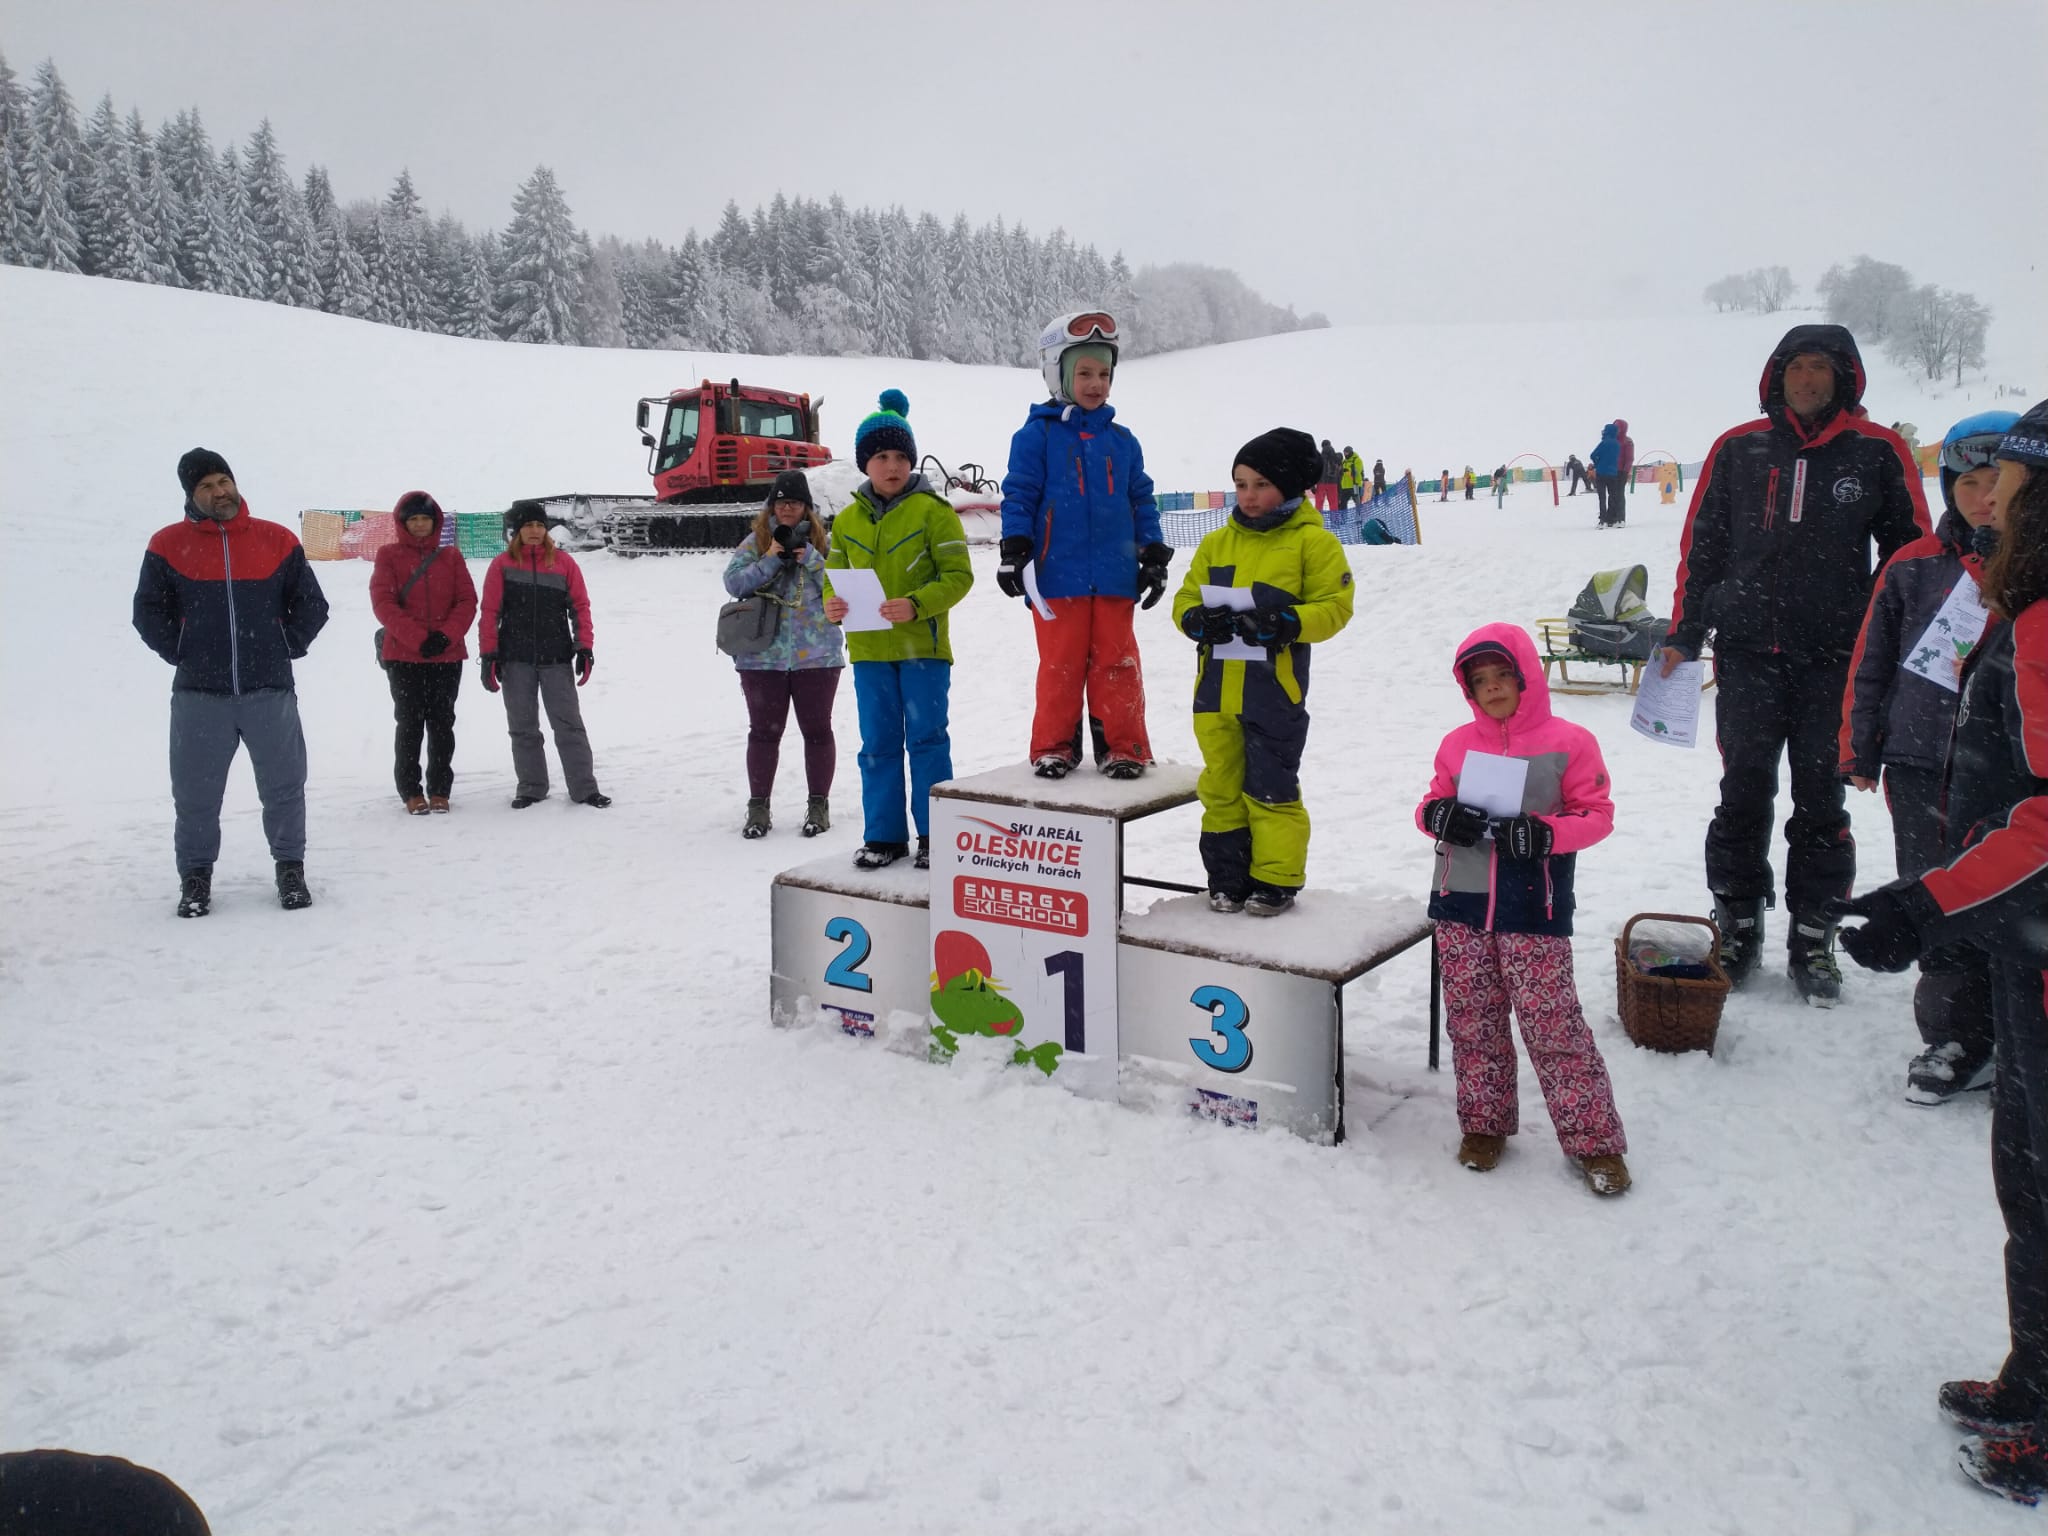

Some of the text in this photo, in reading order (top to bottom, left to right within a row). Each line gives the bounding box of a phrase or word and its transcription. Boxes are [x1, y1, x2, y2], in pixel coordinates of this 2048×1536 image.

[1009, 822, 1083, 842] SKI AREÁL
[1516, 826, 1527, 854] reusch
[957, 854, 1081, 879] v Orlických horách
[964, 882, 1075, 911] ENERGY
[964, 896, 1077, 929] SKISCHOOL
[824, 916, 872, 993] 2
[1044, 950, 1085, 1053] 1
[1189, 985, 1253, 1073] 3
